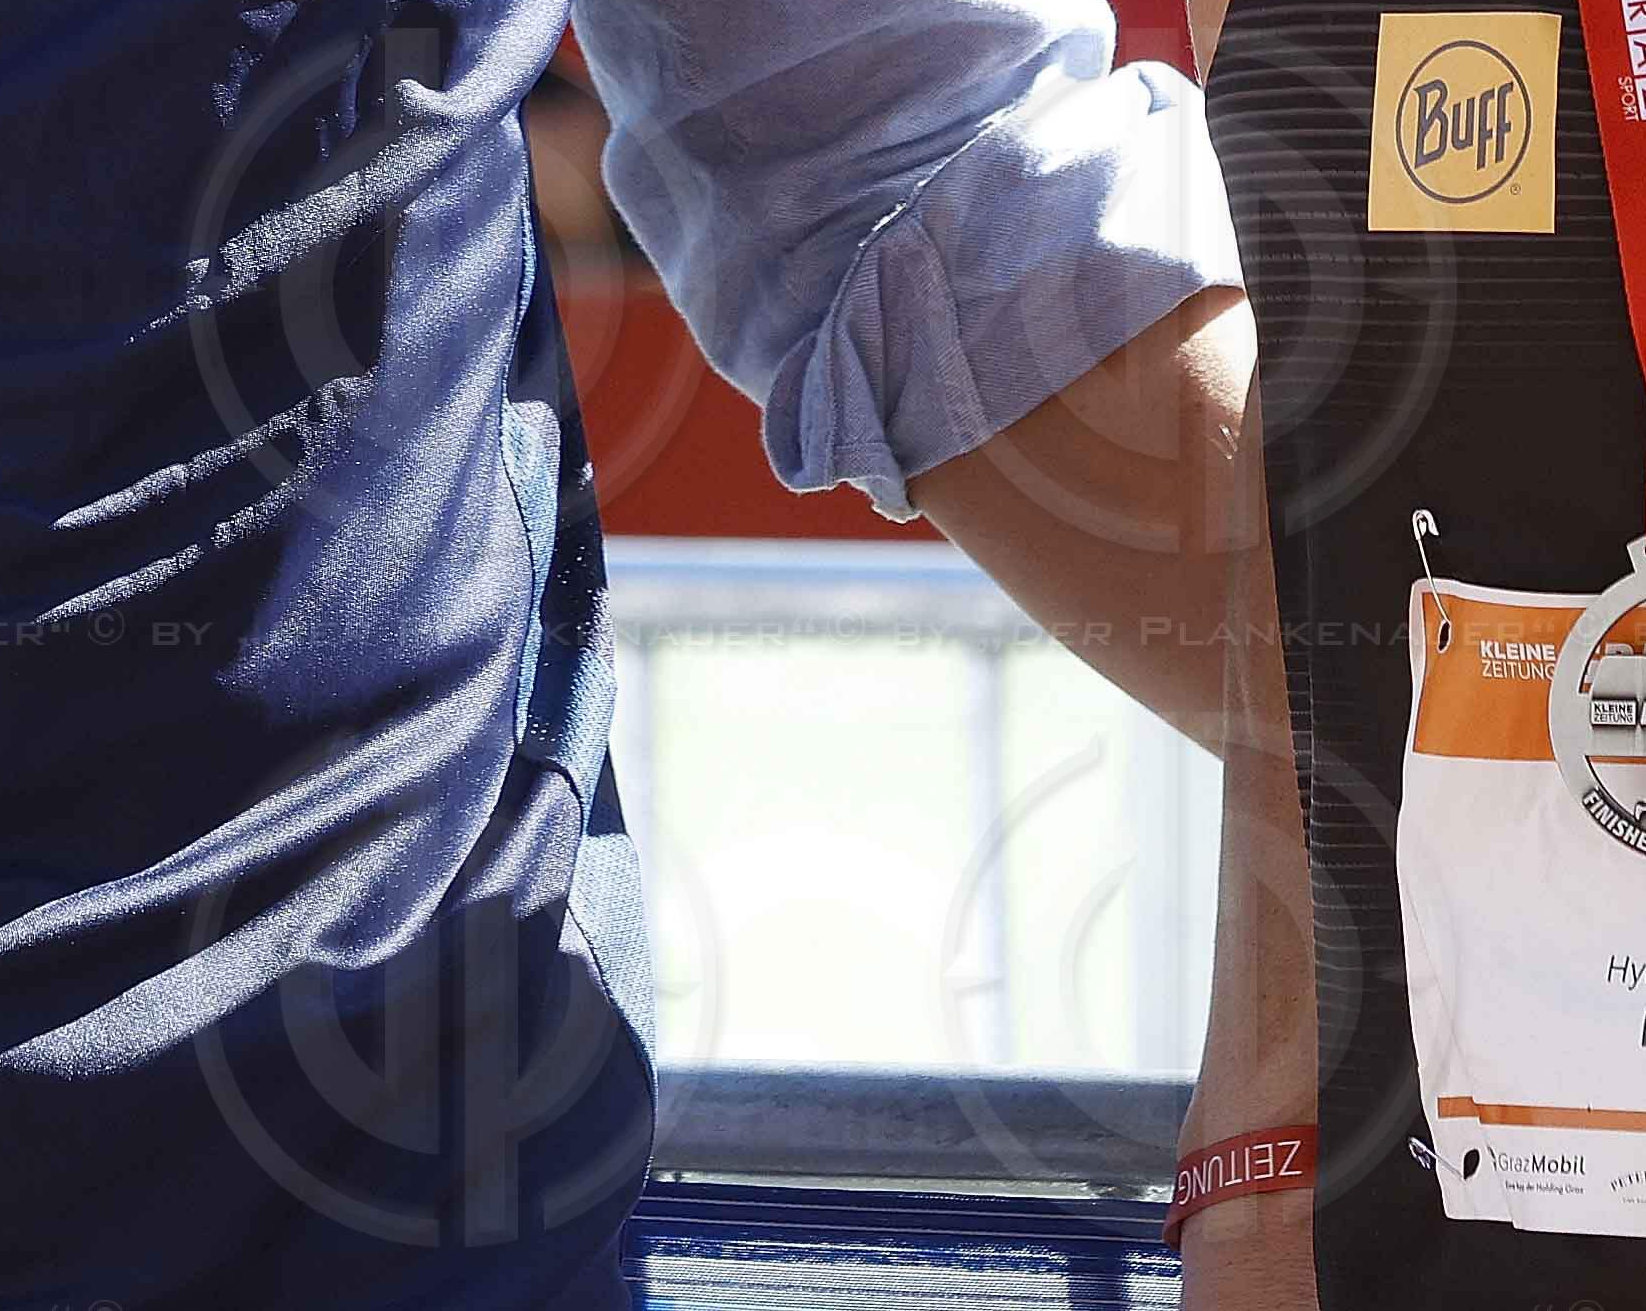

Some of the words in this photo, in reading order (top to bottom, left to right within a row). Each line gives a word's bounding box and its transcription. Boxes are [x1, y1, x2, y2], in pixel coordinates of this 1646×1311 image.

[1616, 76, 1639, 123] SPORT
[1479, 640, 1556, 663] KLEINE
[1593, 703, 1633, 713] KLEINE
[1593, 713, 1634, 724] ZEITUNG
[1178, 1140, 1304, 1206] ZEITUNG
